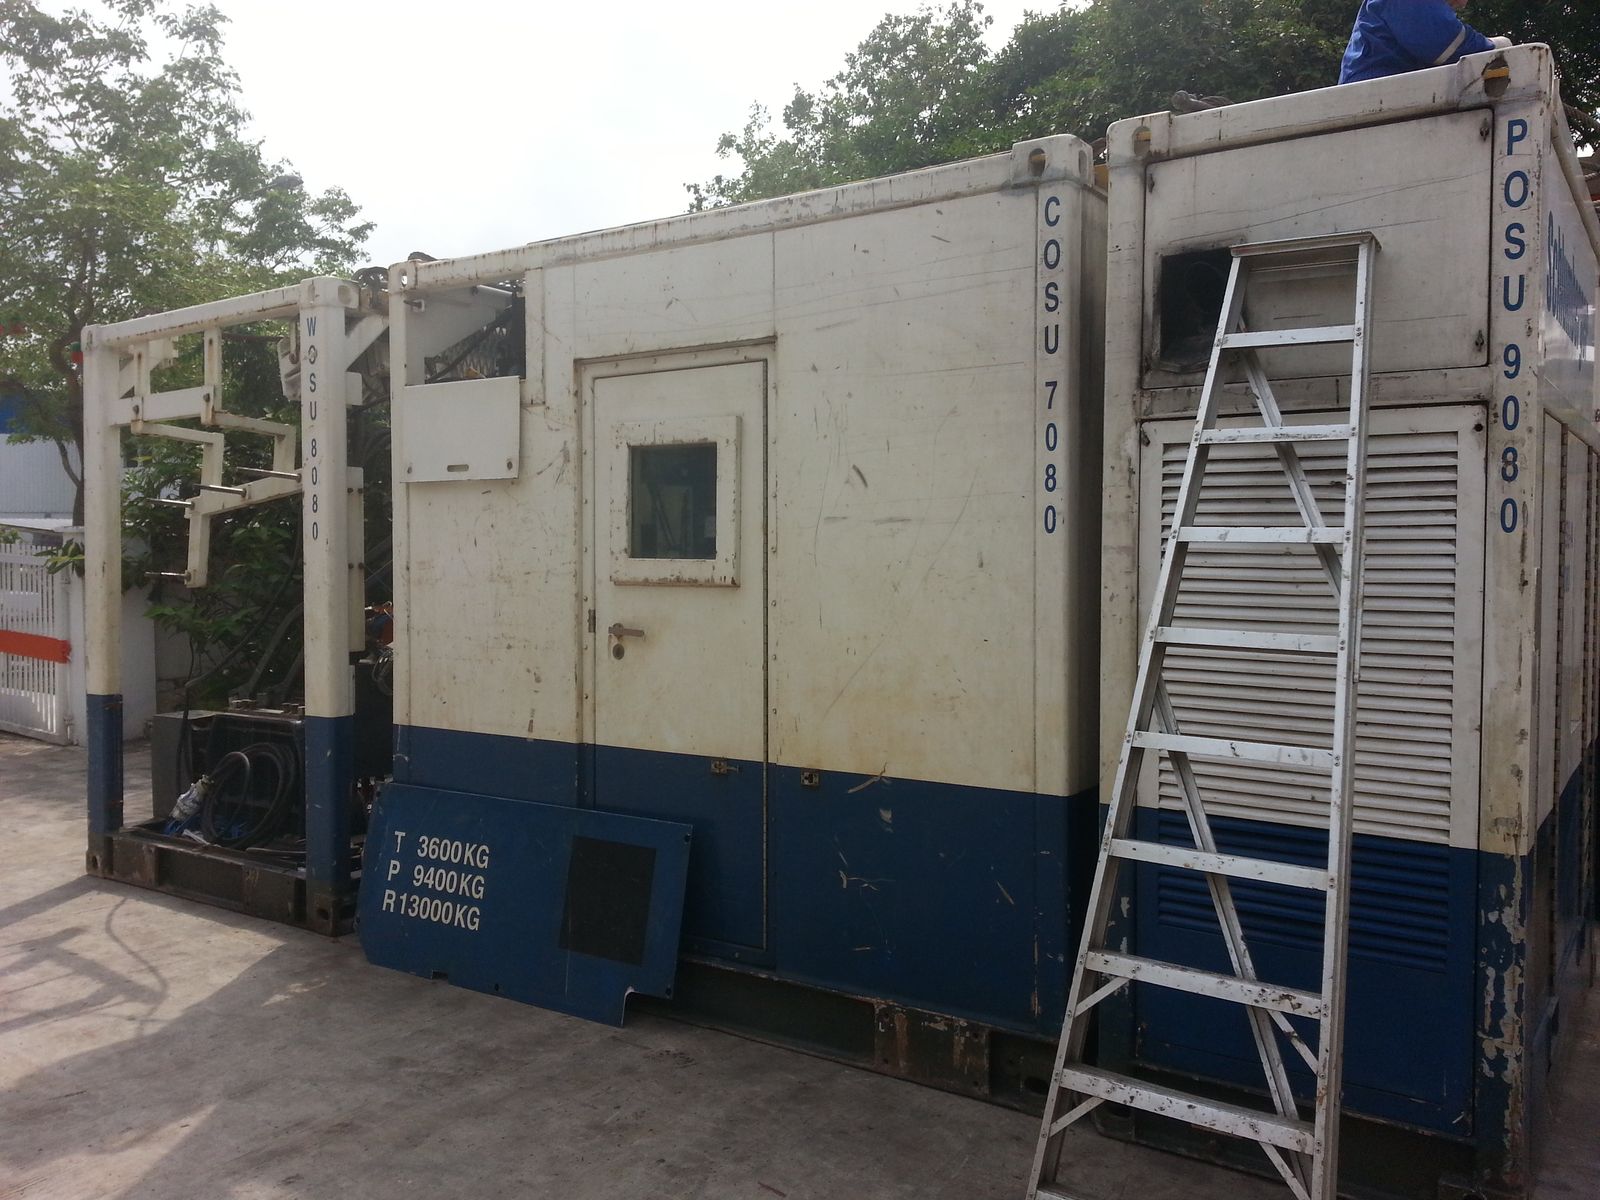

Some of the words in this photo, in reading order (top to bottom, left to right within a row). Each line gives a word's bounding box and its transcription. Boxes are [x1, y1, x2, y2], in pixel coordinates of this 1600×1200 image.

[1044, 196, 1061, 354] COSU
[1503, 119, 1528, 312] POSU
[306, 316, 317, 420] WOSU
[1044, 380, 1058, 534] 7080
[1500, 343, 1521, 534] 9080
[381, 889, 396, 912] R
[387, 859, 401, 881] P
[412, 864, 485, 899] 9400KG
[394, 830, 406, 853] T
[417, 835, 490, 869] 3600KG
